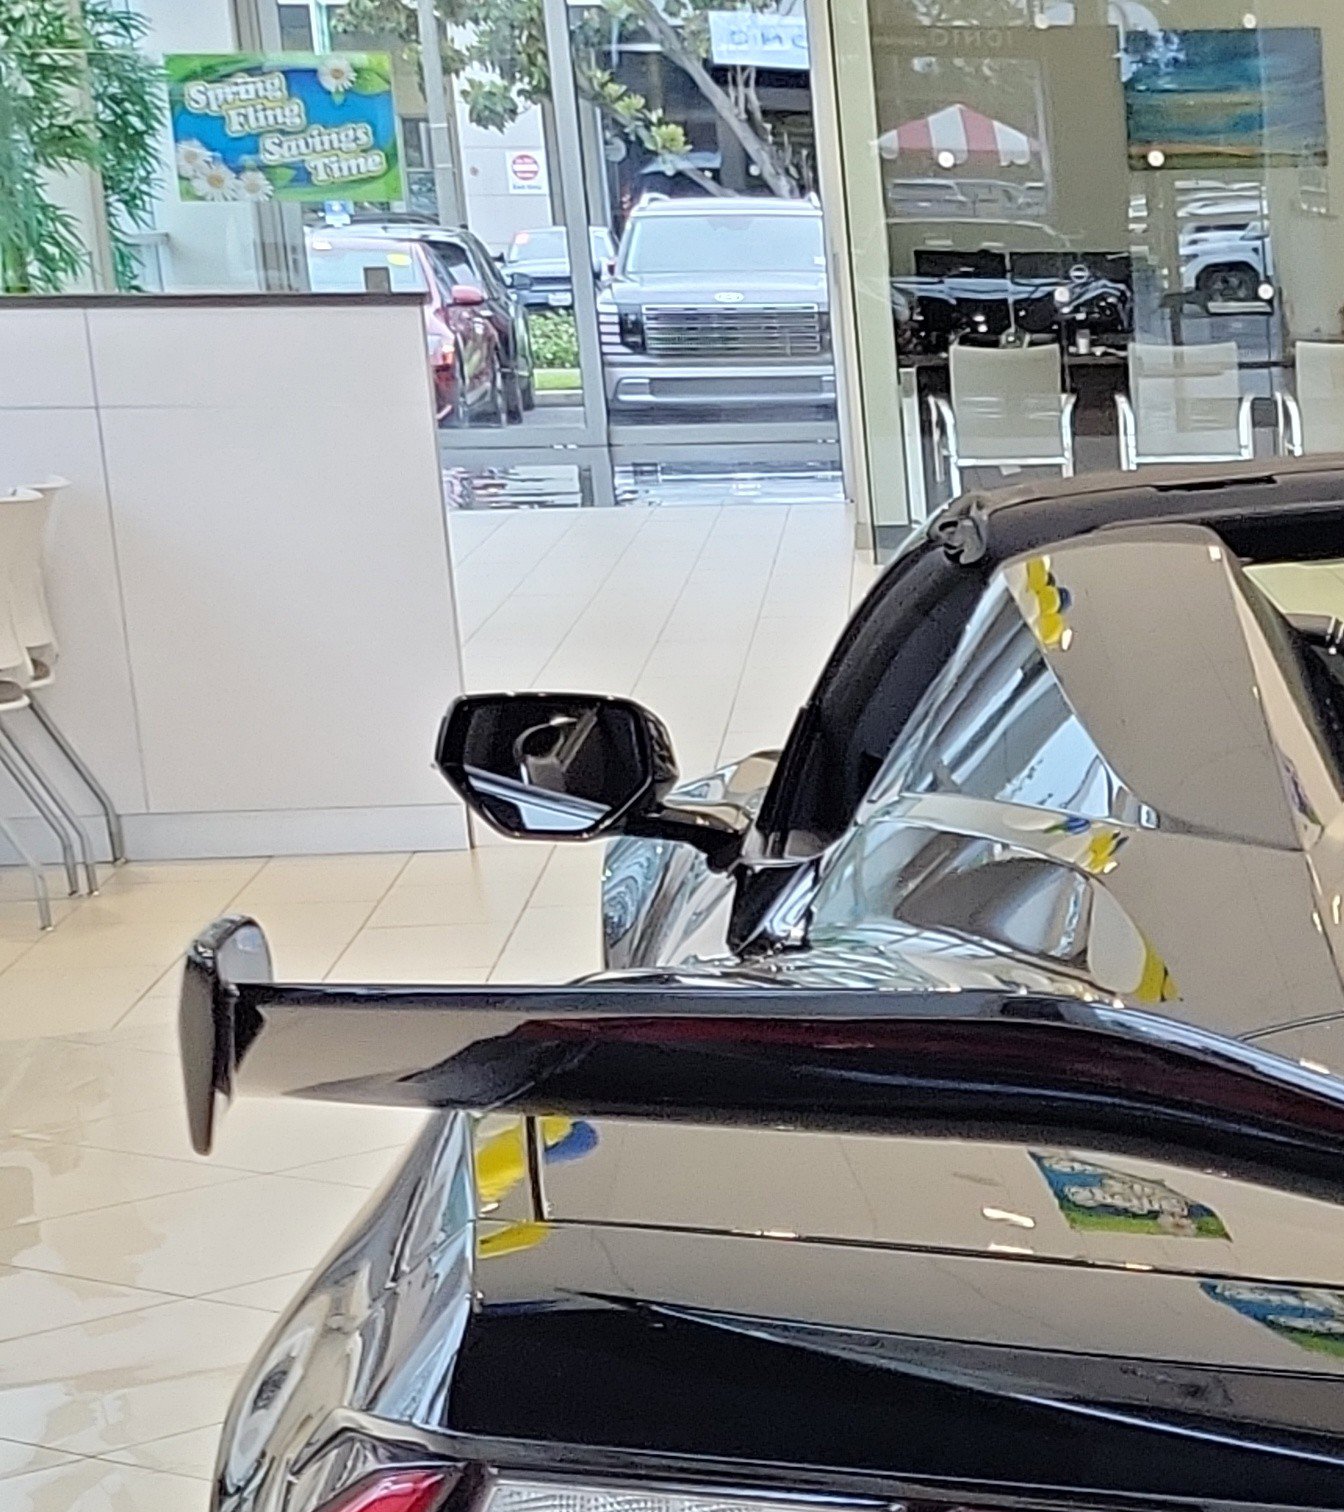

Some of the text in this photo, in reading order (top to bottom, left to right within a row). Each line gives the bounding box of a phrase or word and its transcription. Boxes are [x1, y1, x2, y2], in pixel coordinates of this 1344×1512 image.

[187, 74, 284, 112] Spring
[227, 100, 303, 134] Fling
[262, 124, 370, 161] Savings
[307, 152, 384, 182] Time
